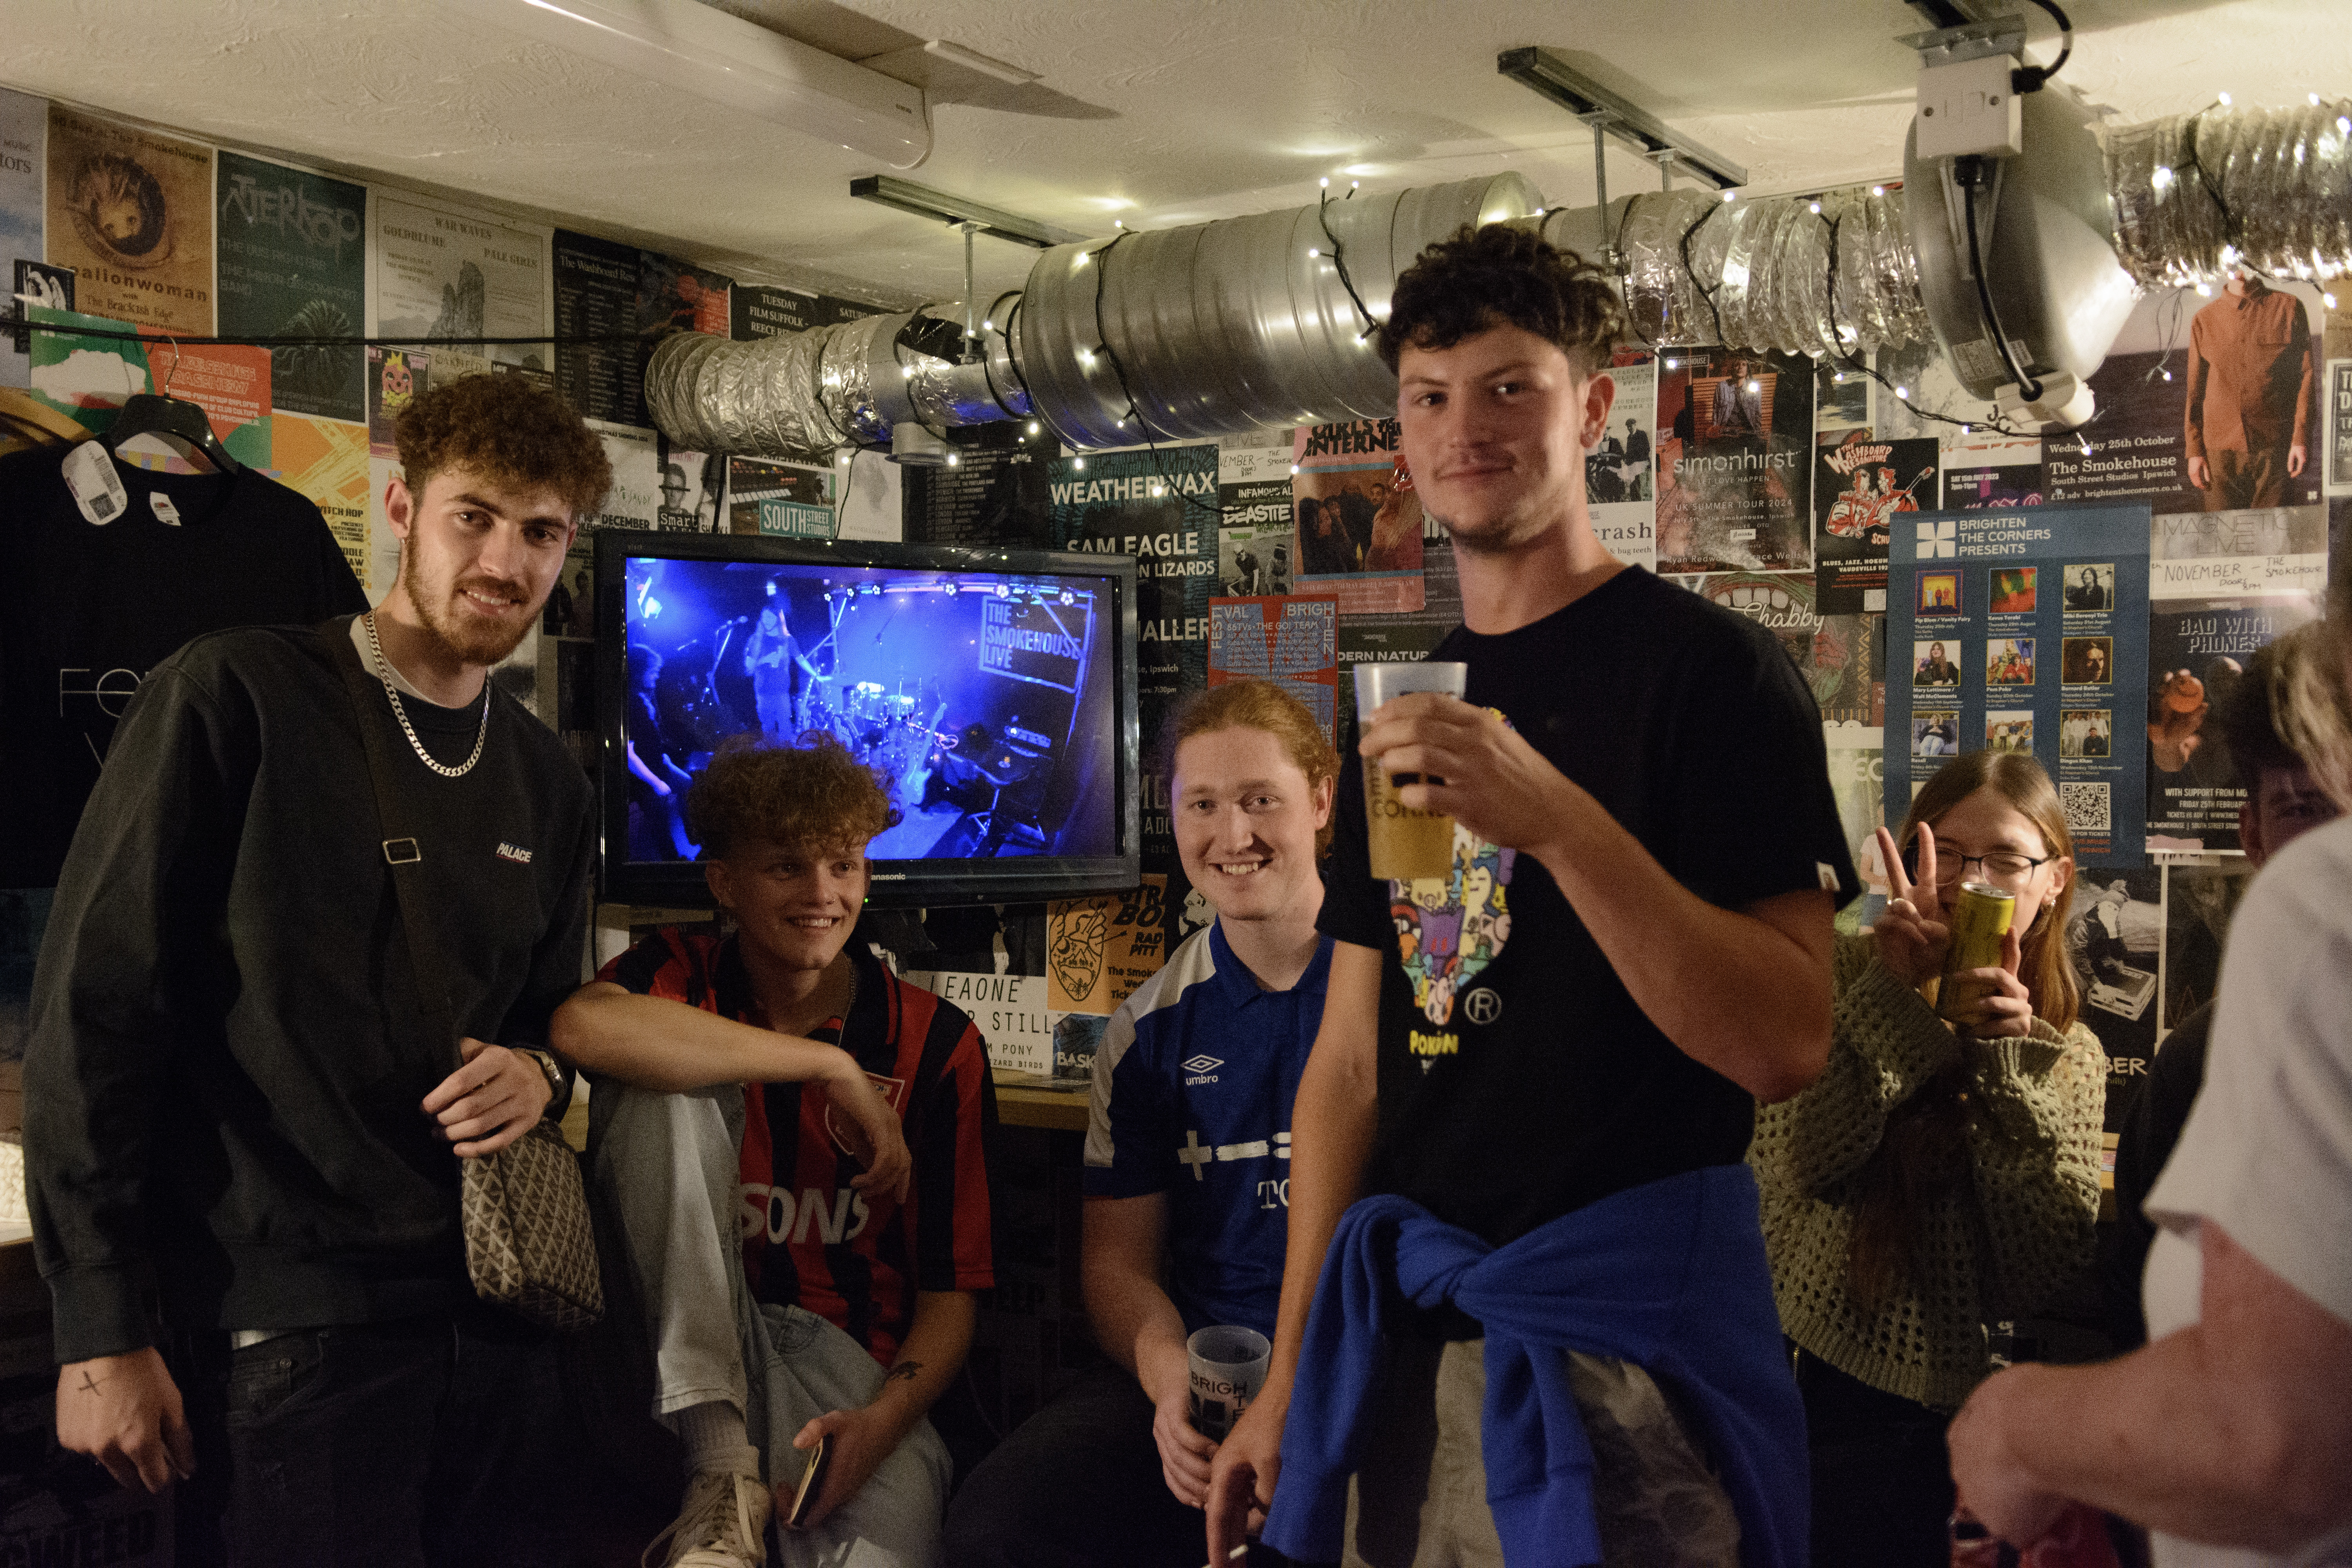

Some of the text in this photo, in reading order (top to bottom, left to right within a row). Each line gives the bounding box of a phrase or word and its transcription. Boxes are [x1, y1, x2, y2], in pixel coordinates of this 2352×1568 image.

[434, 217, 492, 240] WAR WAVES
[761, 294, 797, 310] TUESDAY
[750, 306, 804, 327] FILM SUFFOLK
[2049, 436, 2175, 454] Wedneday 25th October
[1673, 447, 1795, 474] simonhirst
[2049, 456, 2177, 475] The Smokehouse
[1737, 474, 1770, 483] HAPPEN
[2051, 468, 2177, 486] South Street Studios Ipswich
[1050, 471, 1215, 506] WEATHERWAX
[1692, 501, 1733, 510] SUMMER
[1738, 500, 1764, 508] TOUR
[1769, 499, 1793, 508] 2024
[601, 514, 650, 529] DECEMBER
[660, 512, 698, 528] Smart
[764, 504, 806, 534] SOUTH
[807, 510, 830, 523] STREET
[1960, 517, 2027, 530] BRIGHTEN
[1592, 521, 1652, 541] rash
[1960, 529, 2051, 543] THE CORNERS
[1124, 532, 1199, 557] EAGLE
[1617, 546, 1632, 556] bug
[1633, 546, 1652, 554] teeth
[1960, 543, 2026, 556] PRESENTS
[1666, 555, 1688, 564] Ryan
[2267, 557, 2285, 566] THE
[1155, 560, 1215, 578] LIZARDS
[2164, 563, 2241, 583] NOVEMBER
[987, 603, 1012, 624] THE
[1138, 618, 1210, 642] ALLER
[1256, 621, 1273, 630] THE
[1294, 621, 1318, 629] TEAM
[2178, 617, 2217, 636] BAD
[985, 624, 1082, 661] SMOKEHOUSE
[984, 644, 1013, 669] LIVE
[1338, 651, 1374, 661] DERN
[2164, 788, 2234, 797] WITH SUPPORT FROM
[496, 842, 533, 863] PALACE
[871, 873, 906, 881] anasonic
[1135, 931, 1163, 945] RAD
[1129, 944, 1158, 957] PITT
[1107, 966, 1125, 976] The
[992, 1011, 1051, 1035] STILL
[1002, 1044, 1033, 1056] PONY
[1018, 1060, 1044, 1069] BIRDS
[1185, 1074, 1219, 1086] umbro
